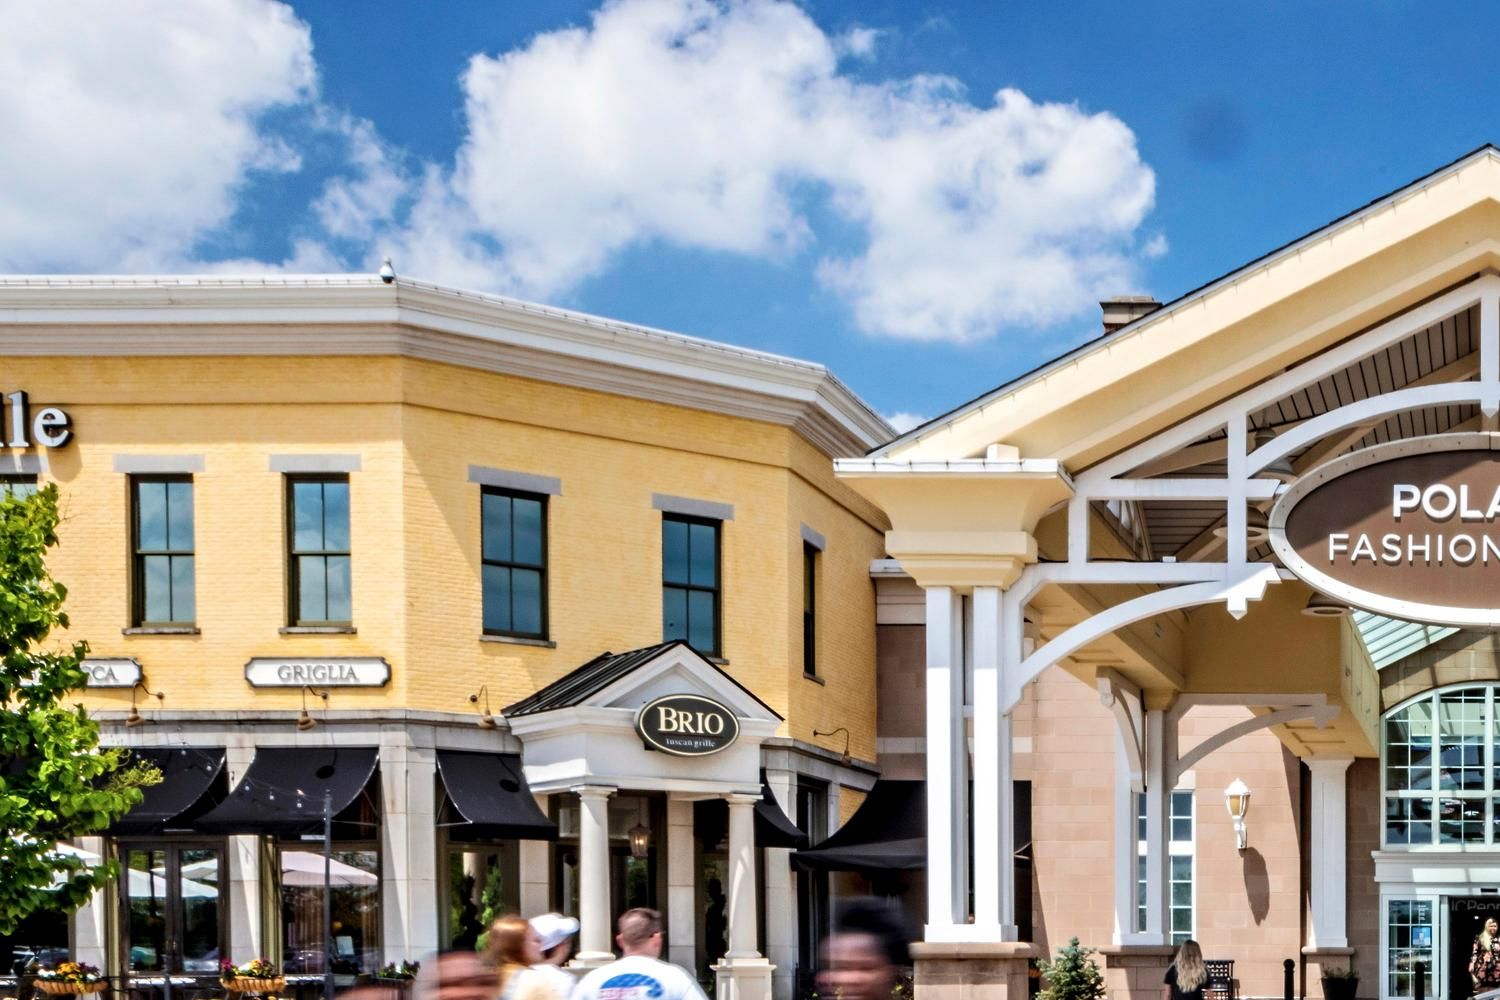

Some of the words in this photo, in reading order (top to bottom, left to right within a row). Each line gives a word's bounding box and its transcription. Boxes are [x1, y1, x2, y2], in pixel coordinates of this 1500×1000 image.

[0, 391, 72, 448] le
[277, 664, 360, 682] GRIGLIA
[657, 706, 724, 735] BRIO
[666, 738, 693, 747] tuscan
[694, 739, 716, 748] grille
